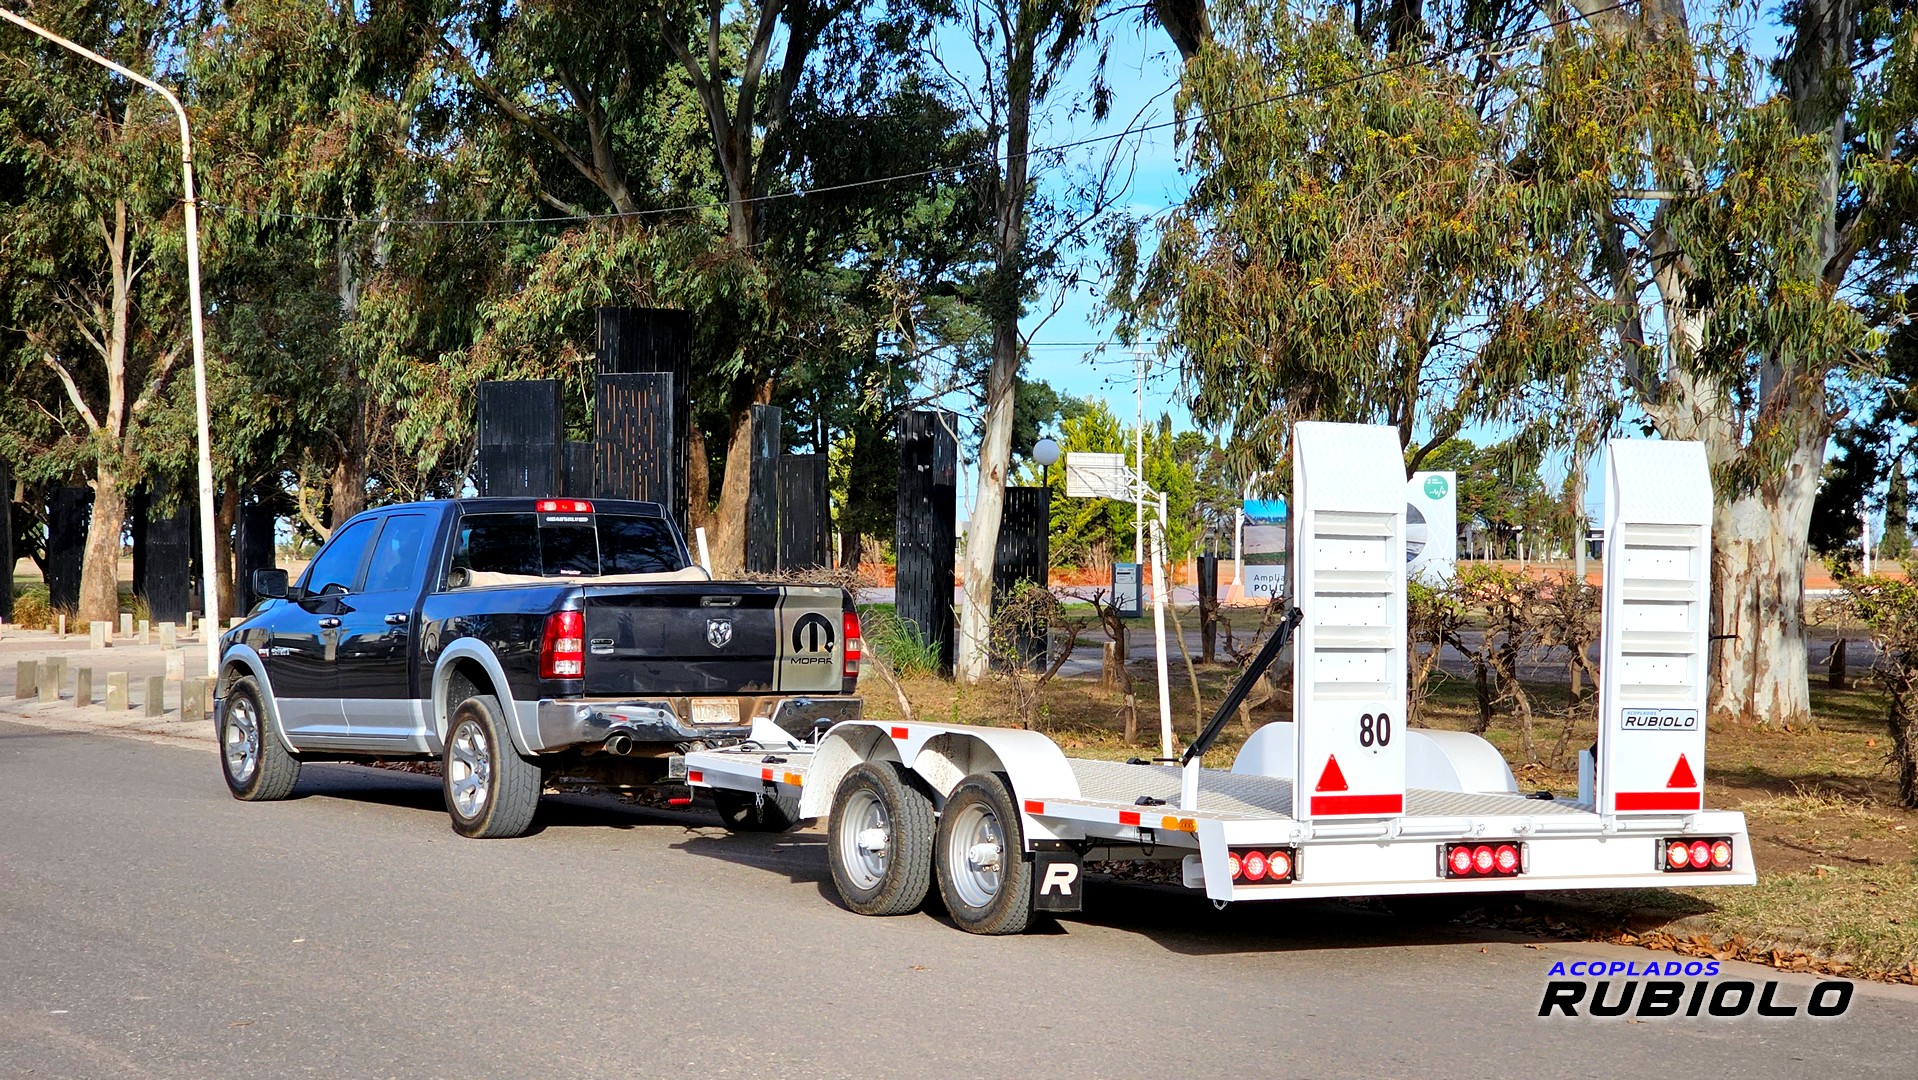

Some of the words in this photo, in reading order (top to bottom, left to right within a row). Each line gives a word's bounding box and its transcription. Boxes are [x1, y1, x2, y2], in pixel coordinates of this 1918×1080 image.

[790, 657, 833, 665] MOPAR
[1359, 712, 1391, 747] 80
[1624, 716, 1696, 727] RUBIOLO
[1040, 863, 1078, 895] R
